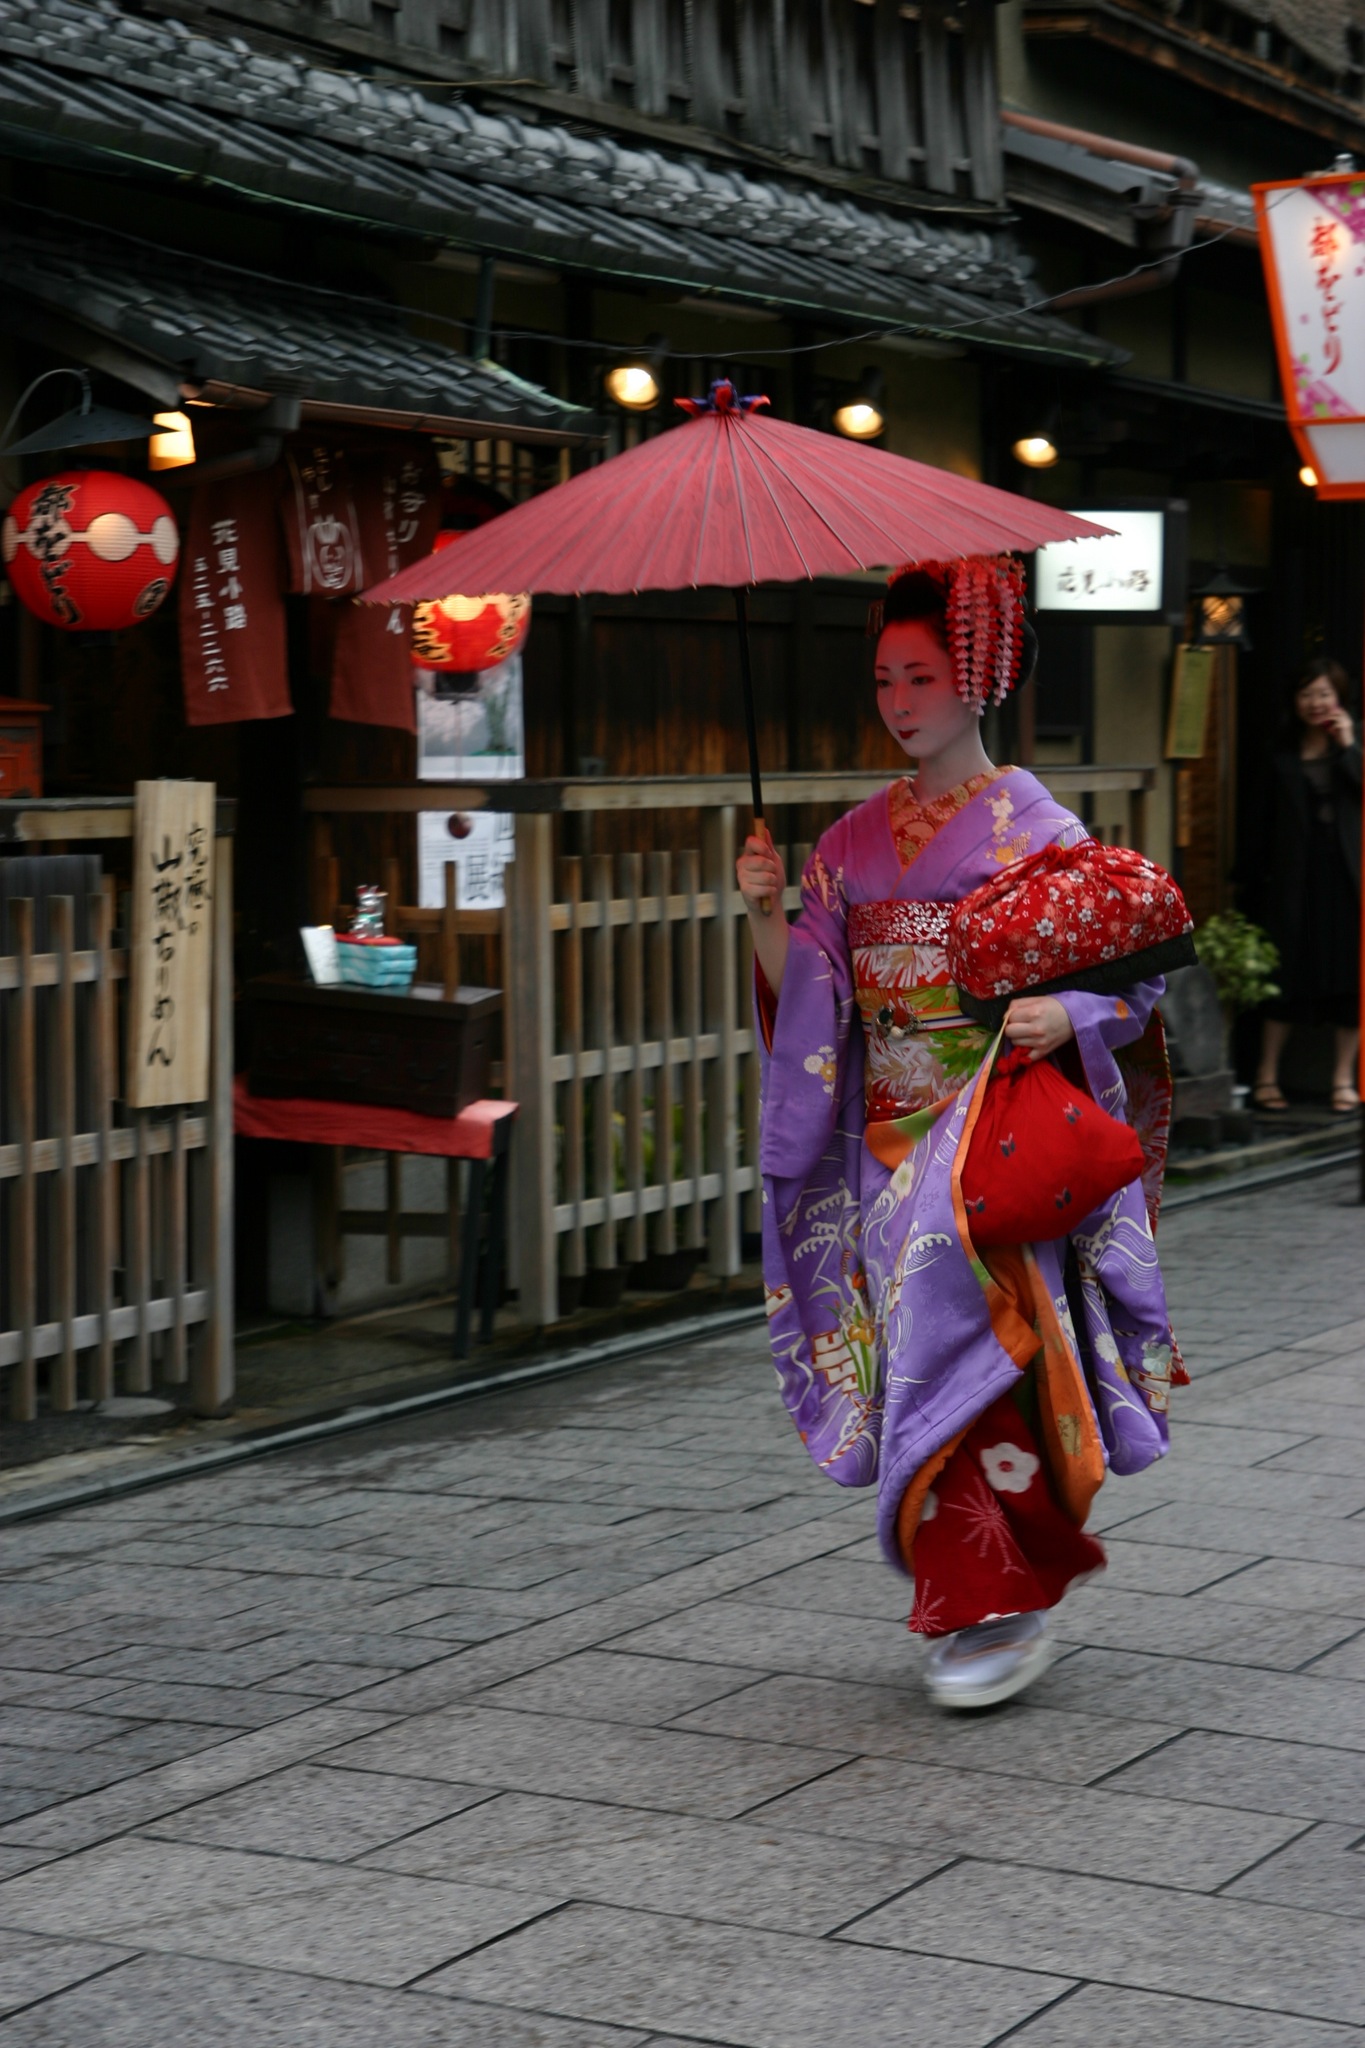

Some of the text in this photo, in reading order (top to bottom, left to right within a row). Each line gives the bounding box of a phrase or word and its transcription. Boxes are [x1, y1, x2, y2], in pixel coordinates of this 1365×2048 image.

[1308, 215, 1346, 377] 都をどり
[32, 482, 84, 624] 都をどり
[210, 518, 249, 631] 花見小路
